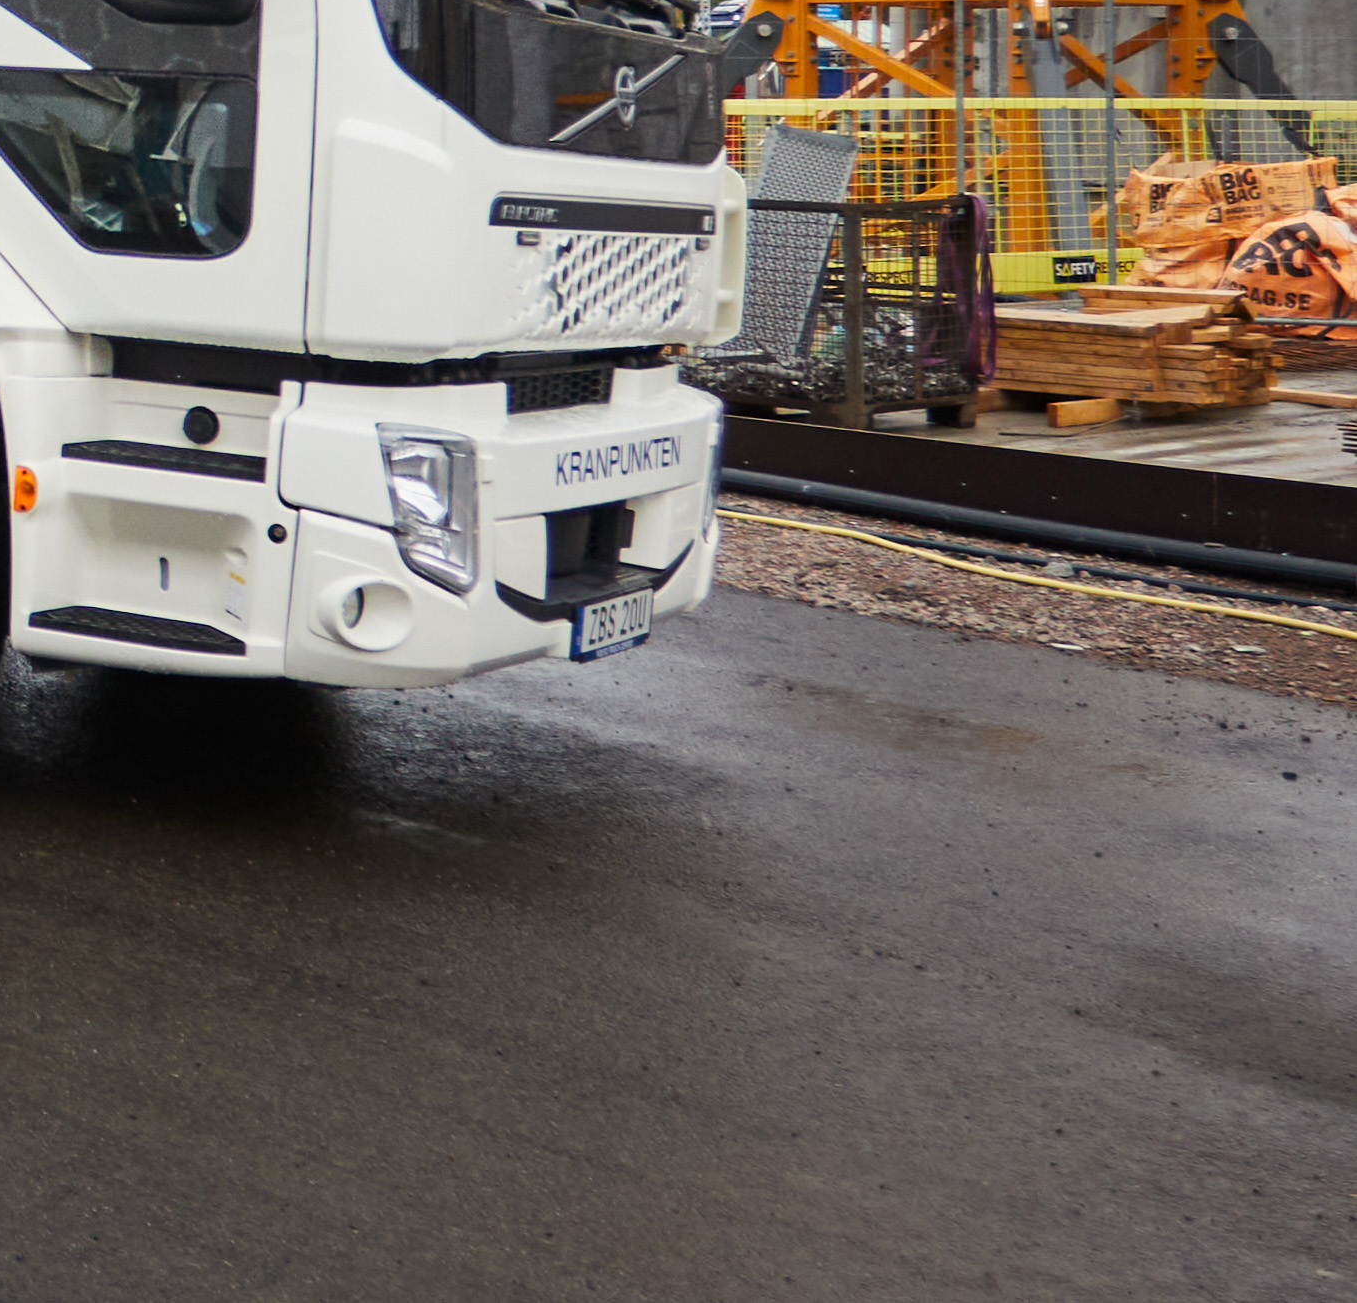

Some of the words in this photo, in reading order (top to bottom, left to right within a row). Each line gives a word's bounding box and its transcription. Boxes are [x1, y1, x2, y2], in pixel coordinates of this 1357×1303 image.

[1219, 167, 1257, 191] BIG
[1224, 185, 1262, 205] BAG
[1055, 261, 1096, 277] SAFETY
[555, 435, 681, 487] KRANPUNKTEN
[588, 603, 617, 646] ZBS
[619, 593, 648, 636] 20U
